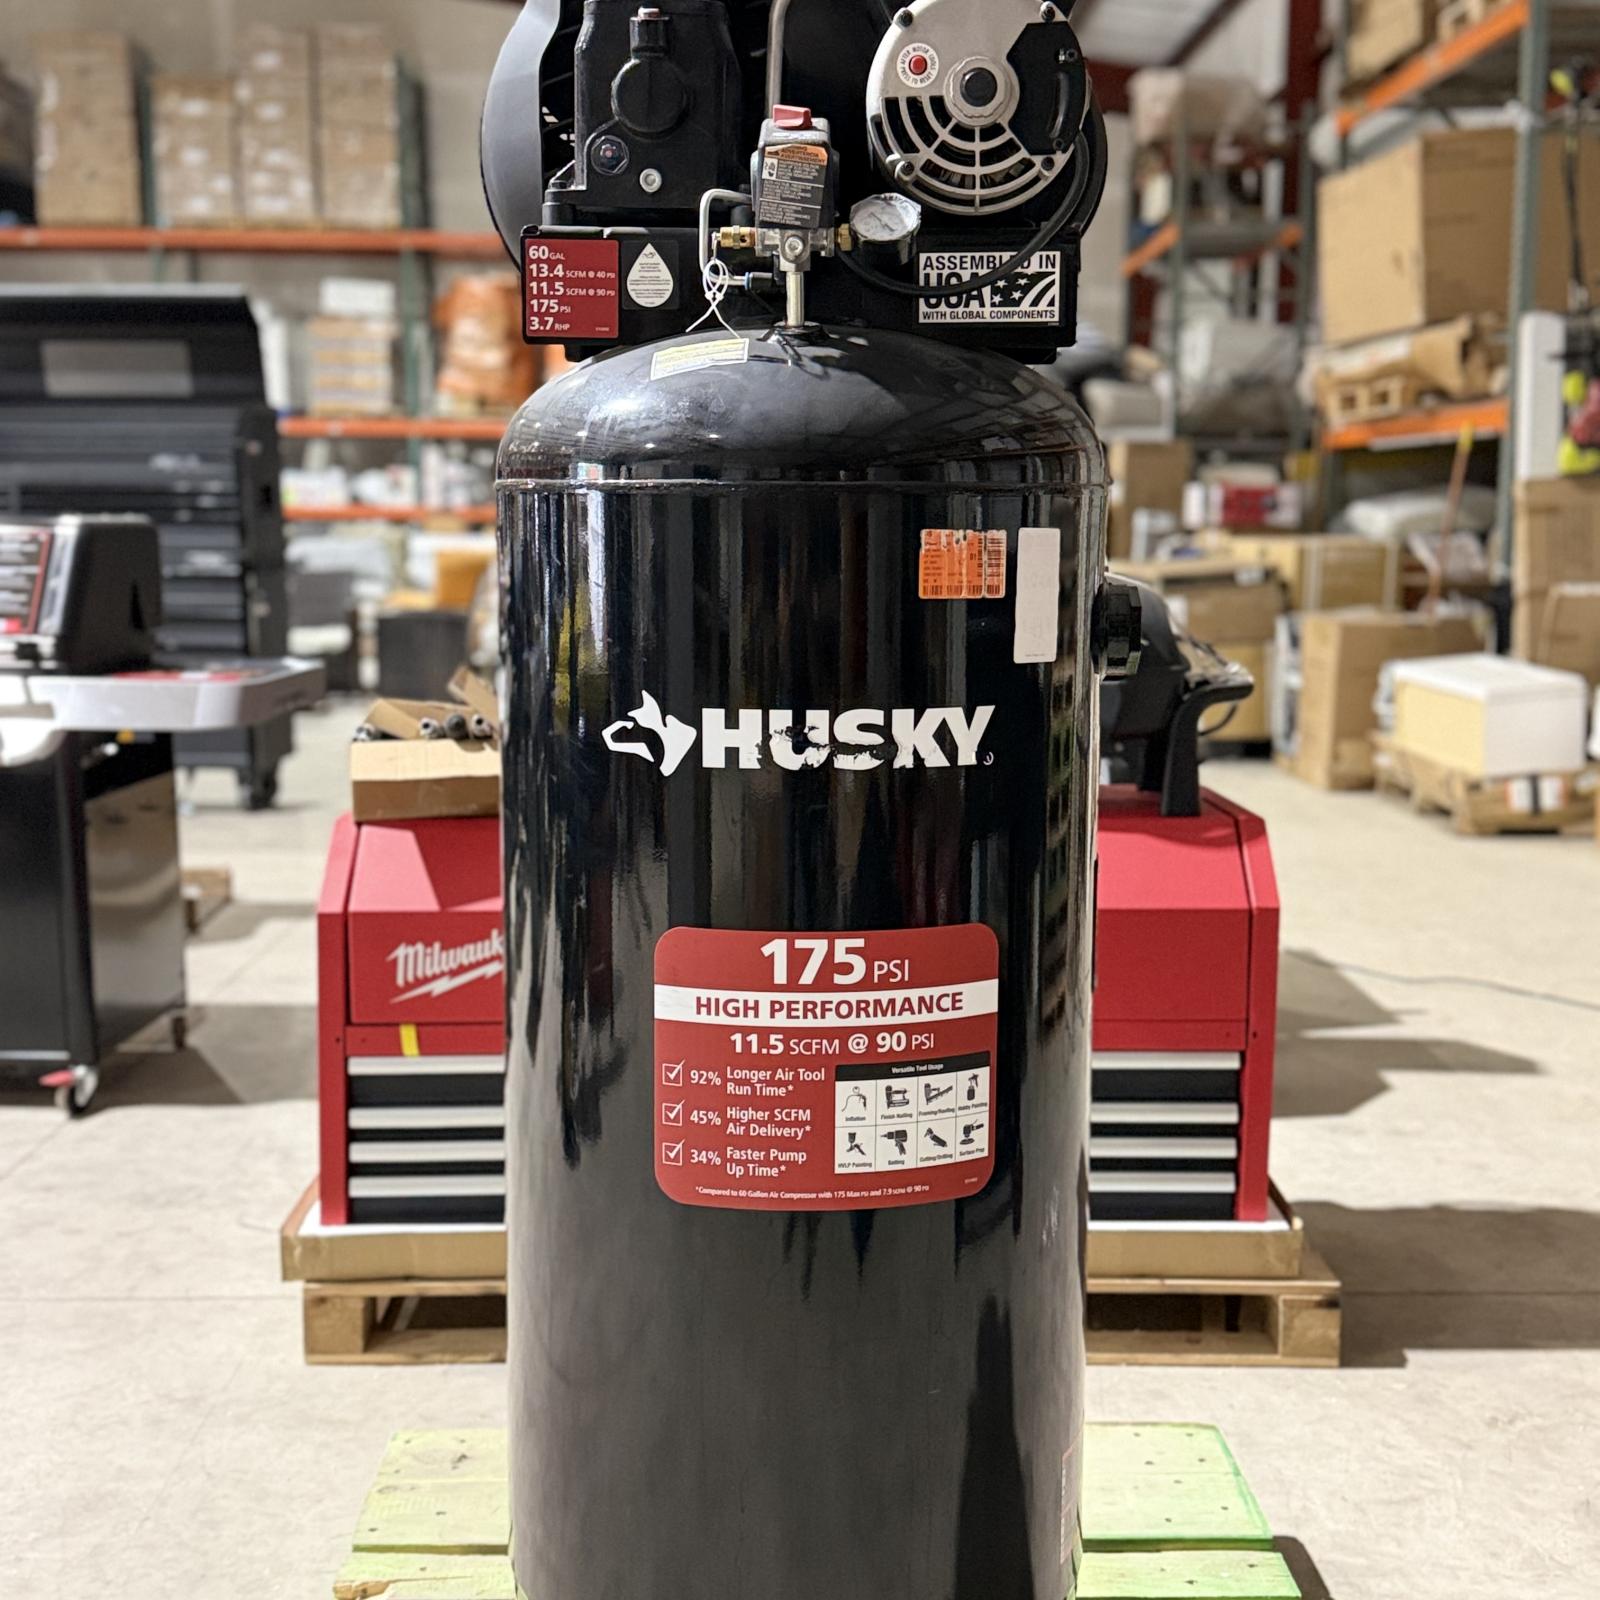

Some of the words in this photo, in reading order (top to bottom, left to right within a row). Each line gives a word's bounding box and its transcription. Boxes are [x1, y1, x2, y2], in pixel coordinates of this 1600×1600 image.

[528, 246, 549, 260] 60
[550, 252, 565, 260] GAL
[1039, 254, 1056, 269] IN
[529, 264, 564, 278] 13.4
[566, 270, 586, 278] SCFM
[596, 270, 606, 278] 40
[529, 282, 564, 295] 11.5
[566, 288, 586, 296] SCFM
[596, 288, 606, 296] 90
[530, 299, 559, 313] 175
[922, 311, 947, 320] WITH
[950, 310, 986, 320] GLOBAL
[990, 310, 1056, 319] COMPONENTS
[530, 316, 554, 330] 3.7
[555, 323, 570, 331] RHP
[702, 705, 995, 770] HUSKY
[760, 937, 867, 986] 175
[874, 959, 910, 984] PSI
[696, 996, 760, 1018] HIGH
[769, 992, 964, 1020] PERFORMANCE
[730, 1032, 784, 1055] 11.5
[790, 1038, 840, 1055] SCFM
[848, 1034, 868, 1054] @
[876, 1031, 907, 1052] 90
[912, 1032, 934, 1050] PSI
[690, 1069, 722, 1086] 92%
[726, 1066, 772, 1082] Longer
[775, 1068, 795, 1081] Air
[797, 1067, 825, 1081] Tool
[726, 1082, 752, 1096] Run
[690, 1110, 722, 1126] 45%
[726, 1106, 770, 1122] Higher
[774, 1108, 811, 1121] SCFM
[726, 1122, 746, 1136] Air
[690, 1149, 722, 1166] 34%
[726, 1146, 765, 1161] Faster
[770, 1149, 807, 1164] Pump
[726, 1163, 744, 1178] Up
[747, 1190, 769, 1198] Gallon
[818, 1191, 833, 1199] with
